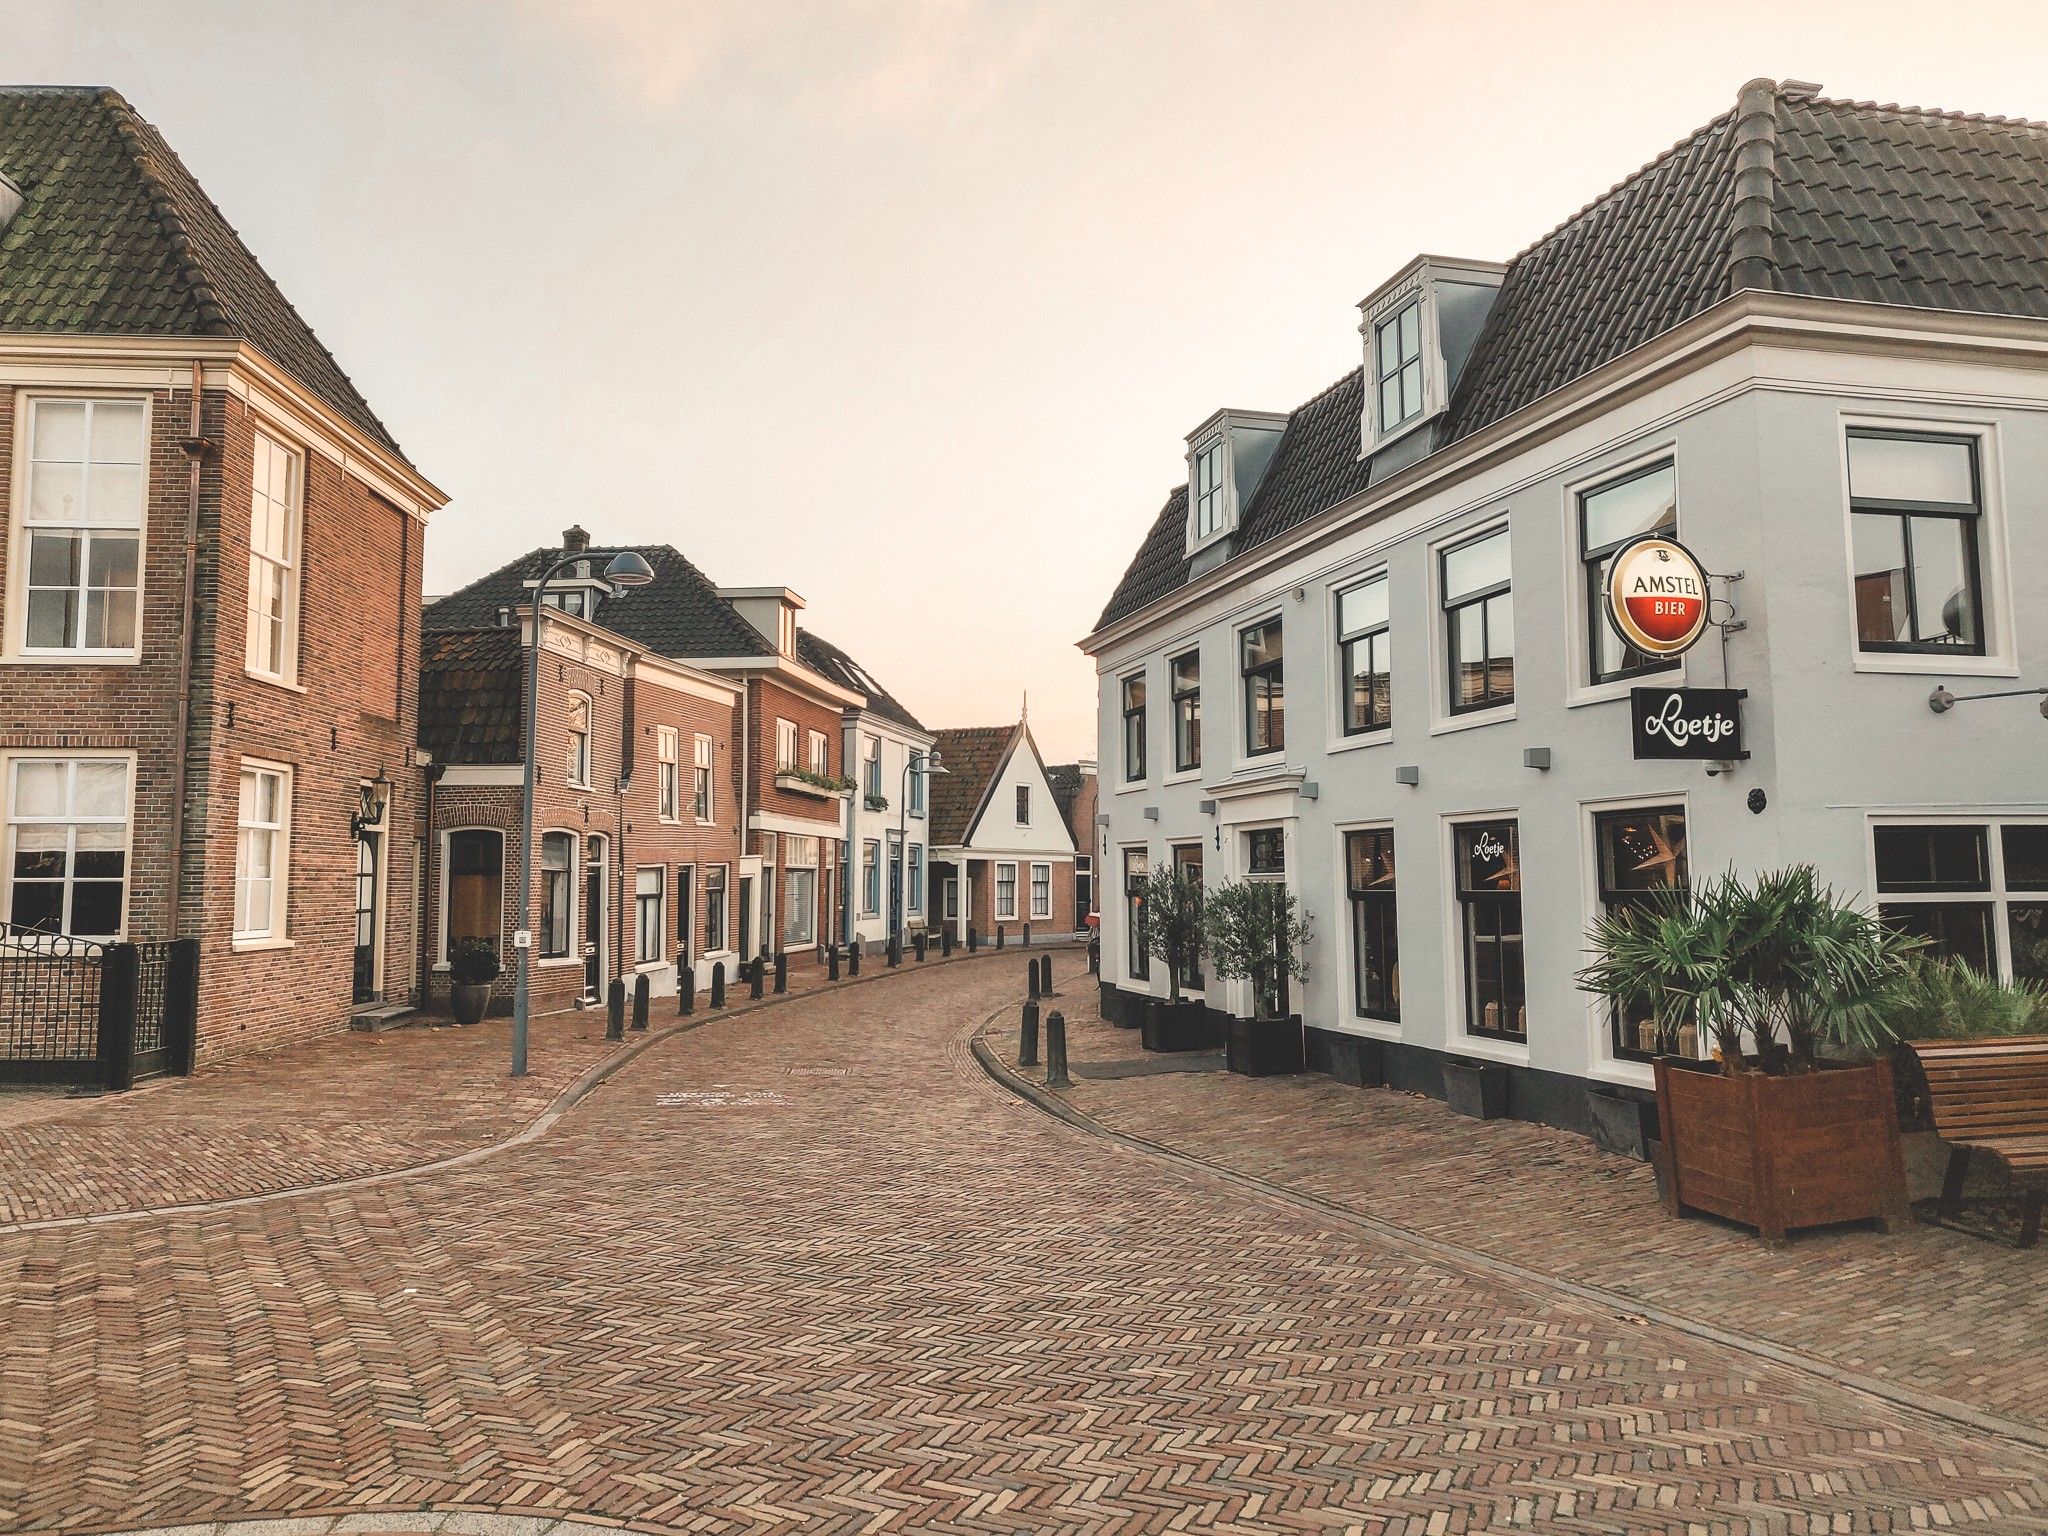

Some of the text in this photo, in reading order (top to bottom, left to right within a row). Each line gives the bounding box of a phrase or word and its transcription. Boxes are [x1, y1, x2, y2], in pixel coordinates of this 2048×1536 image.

[1633, 576, 1699, 595] AMSTEL
[1655, 600, 1686, 615] BIER
[1645, 693, 1734, 747] Loetje
[1474, 831, 1505, 862] Loetje
